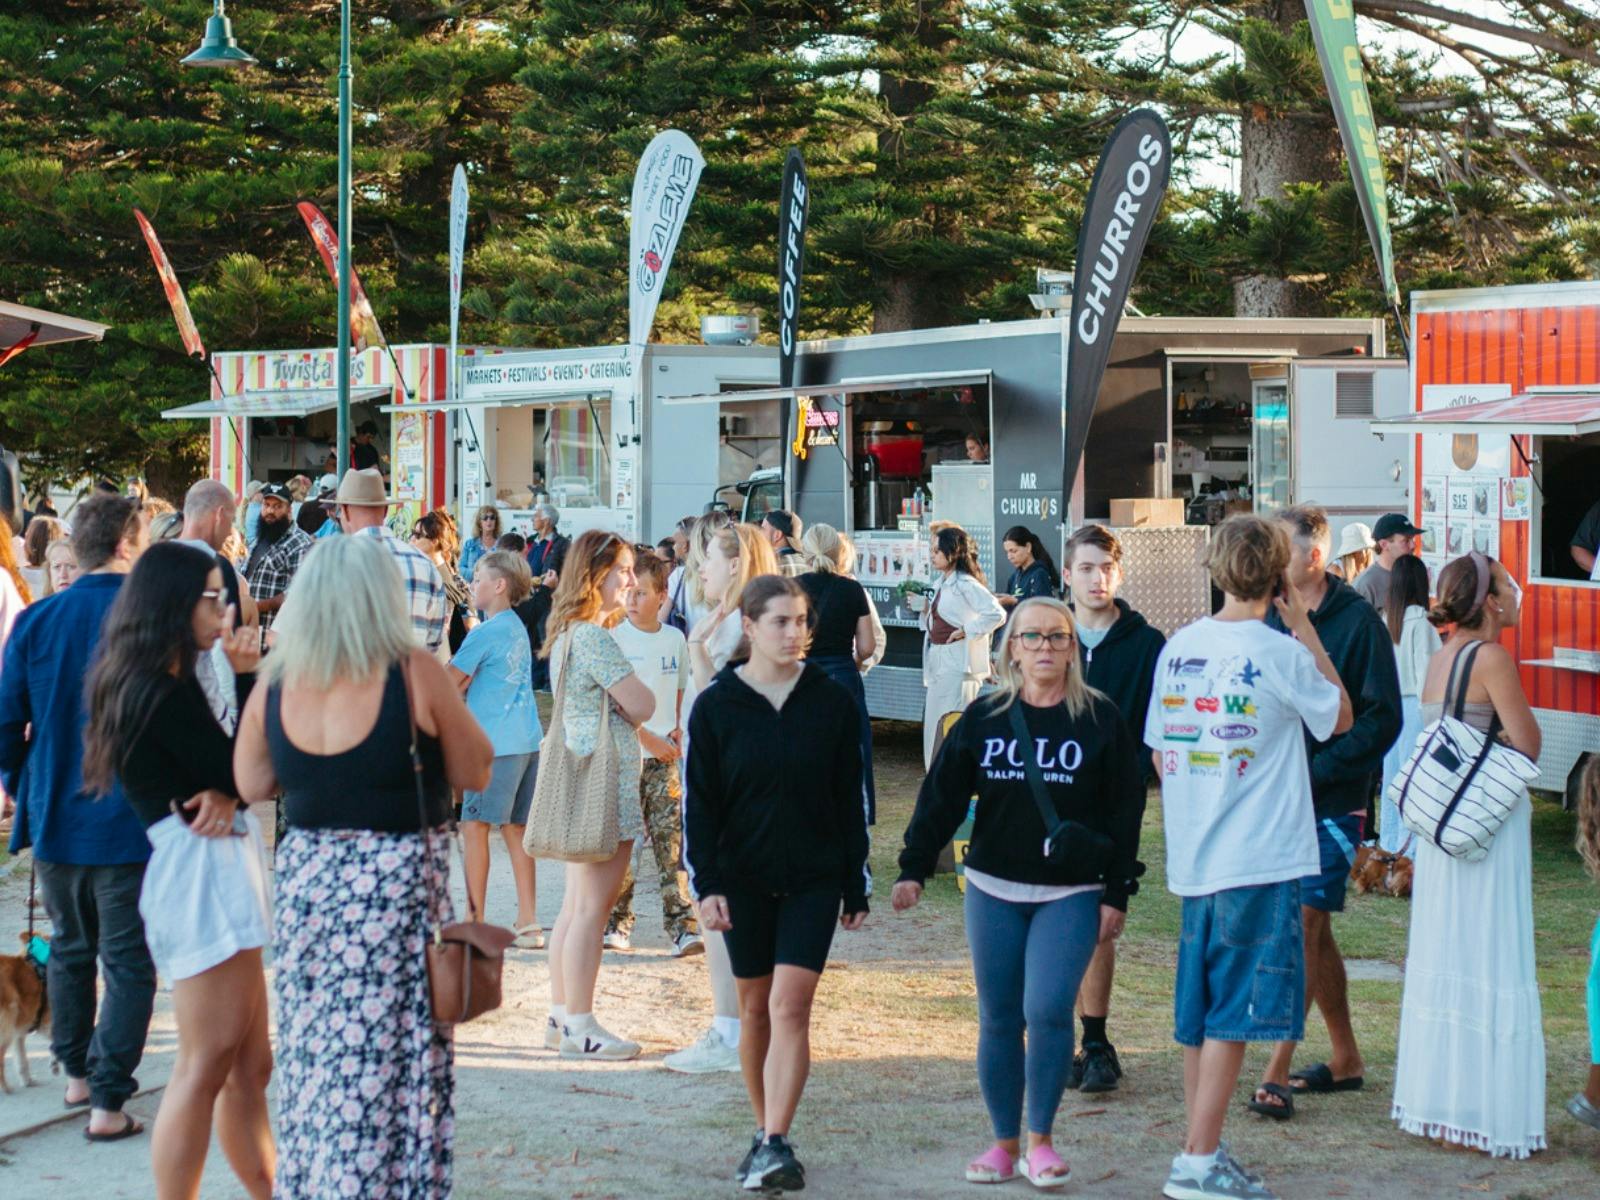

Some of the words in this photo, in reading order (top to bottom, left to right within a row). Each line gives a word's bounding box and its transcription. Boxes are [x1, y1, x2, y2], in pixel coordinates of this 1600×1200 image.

[1078, 134, 1163, 345] CHURROS
[780, 172, 806, 356] COFFEE
[466, 368, 502, 384] MARKETS
[507, 366, 547, 383] FESTIVALS
[553, 364, 583, 380] EVENTS
[590, 361, 632, 379] CATERING
[1020, 472, 1037, 489] MR
[1001, 496, 1057, 519] CHURROS
[661, 656, 677, 670] LA
[986, 770, 1025, 780] RALPH
[1042, 772, 1074, 784] UREN
